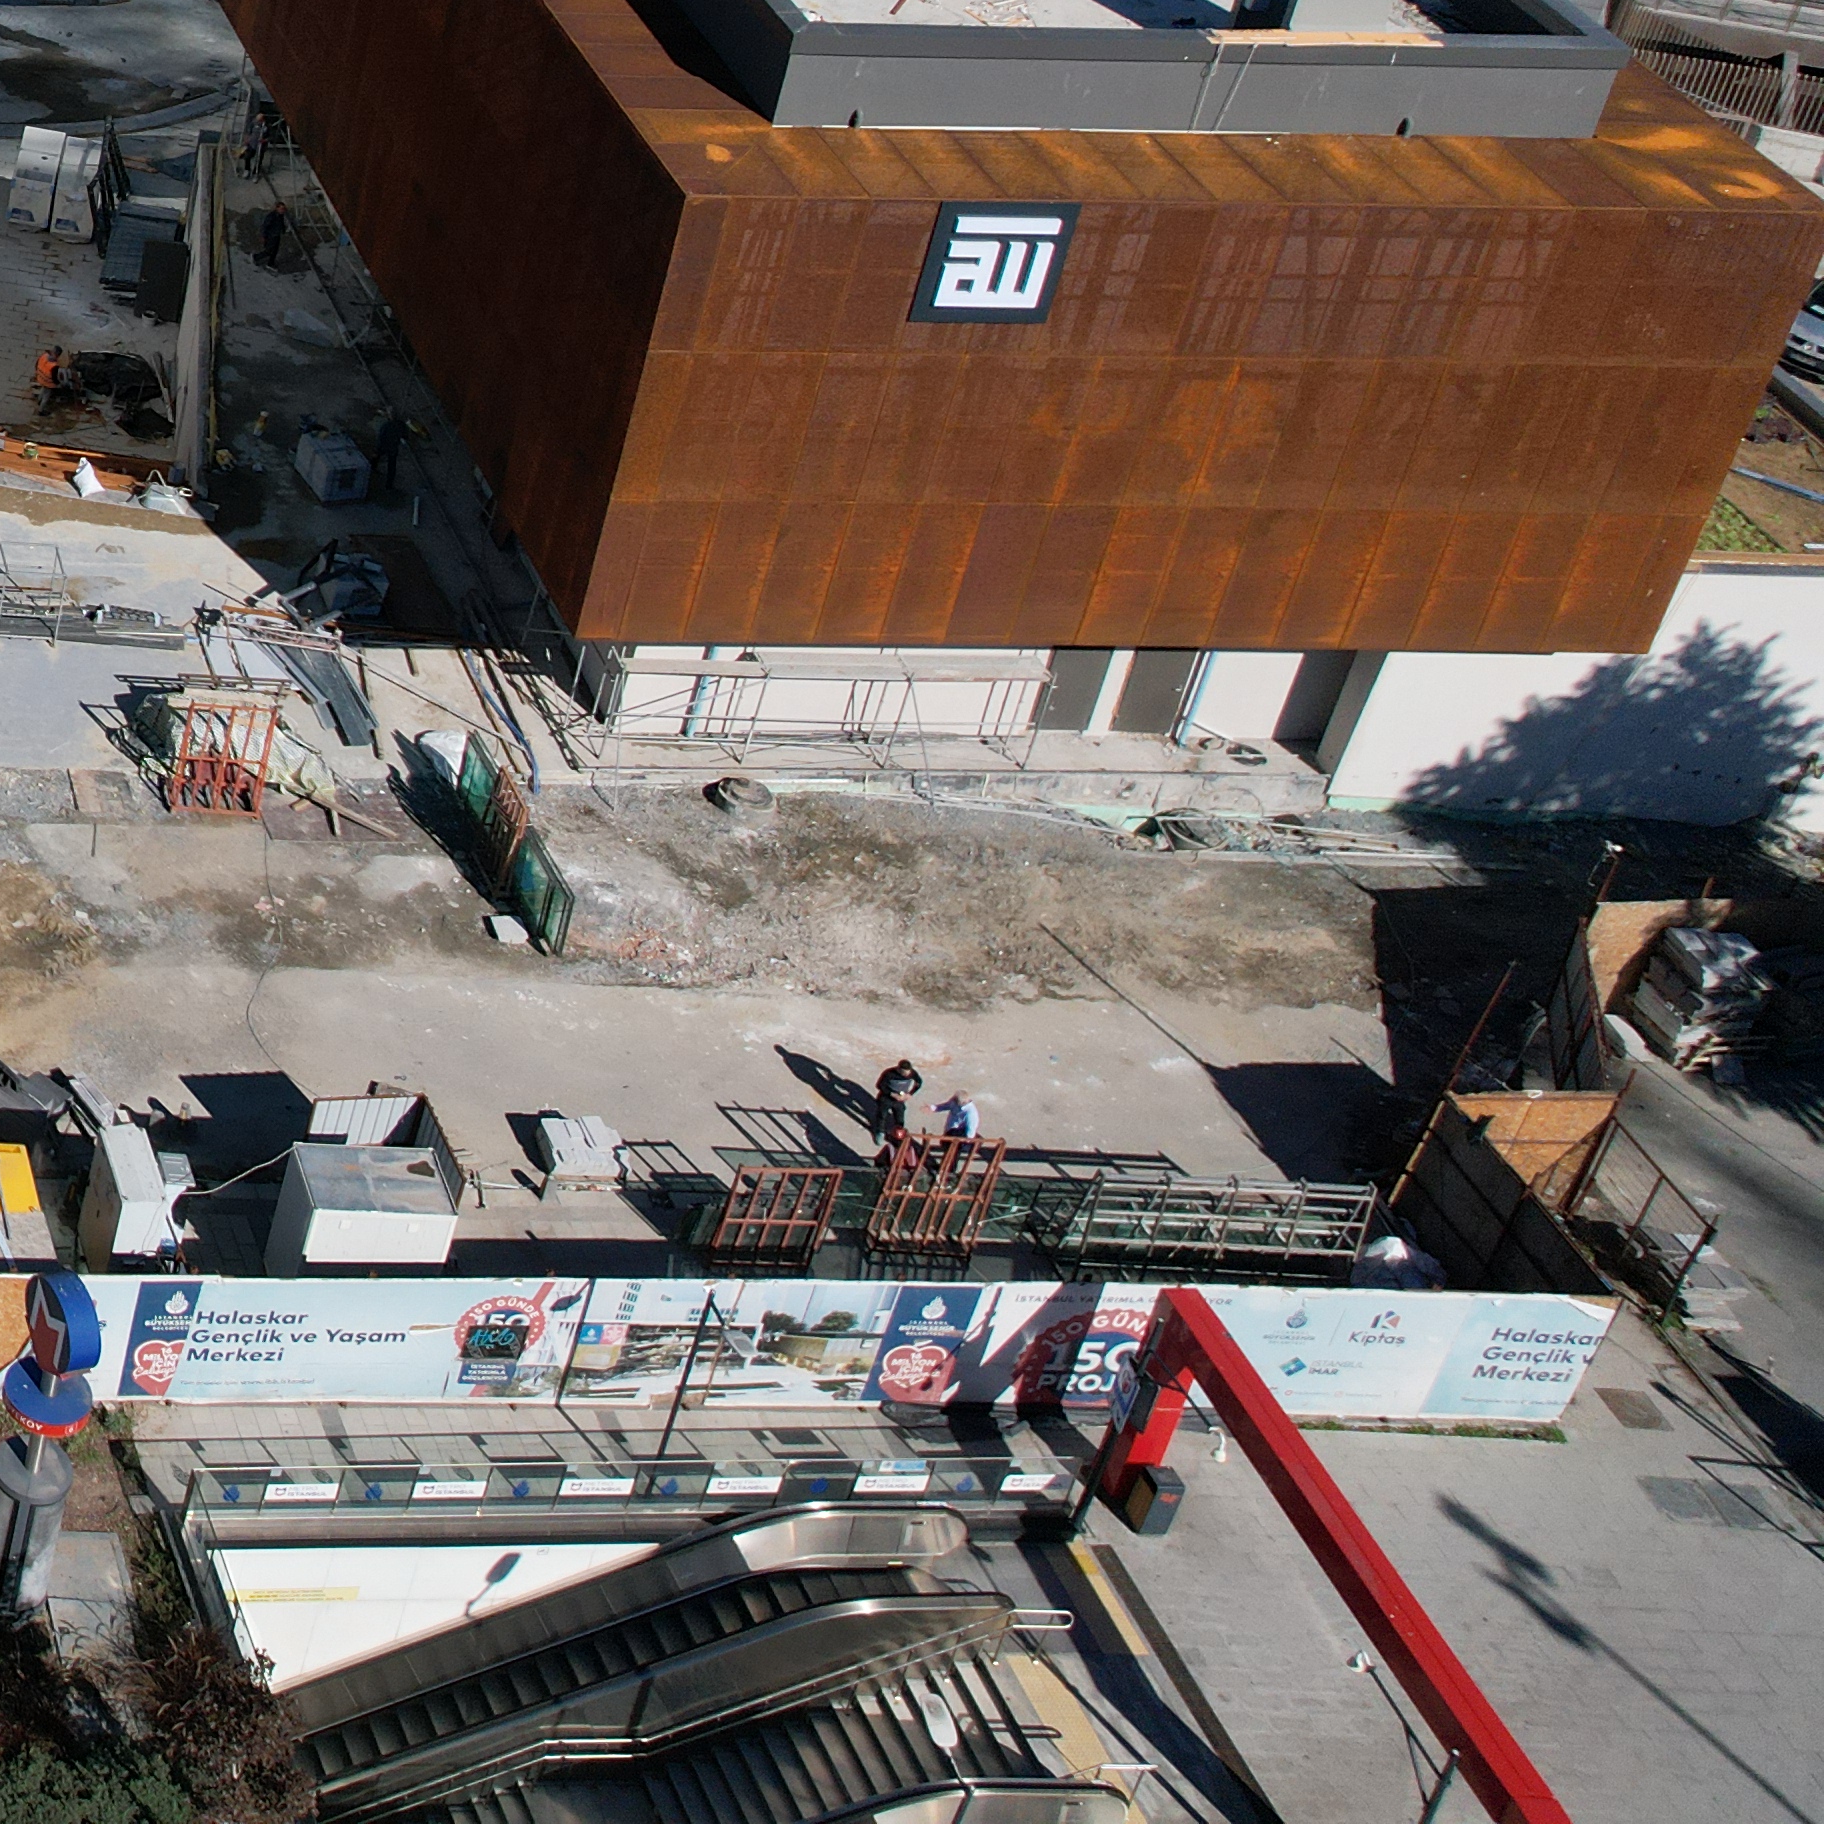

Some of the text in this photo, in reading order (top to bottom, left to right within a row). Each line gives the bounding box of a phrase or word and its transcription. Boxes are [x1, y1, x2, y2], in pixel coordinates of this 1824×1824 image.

[1014, 1292, 1076, 1304] İSTANBUL
[496, 1297, 540, 1319] GÜNDE
[195, 1310, 309, 1325] Halaskar
[191, 1329, 407, 1348] Gençlik ve Yaşam
[1348, 1330, 1406, 1348] Kiptaş
[186, 1347, 285, 1362] Merkezi
[1482, 1345, 1577, 1366] Gençlik
[1472, 1364, 1575, 1383] Merkezi
